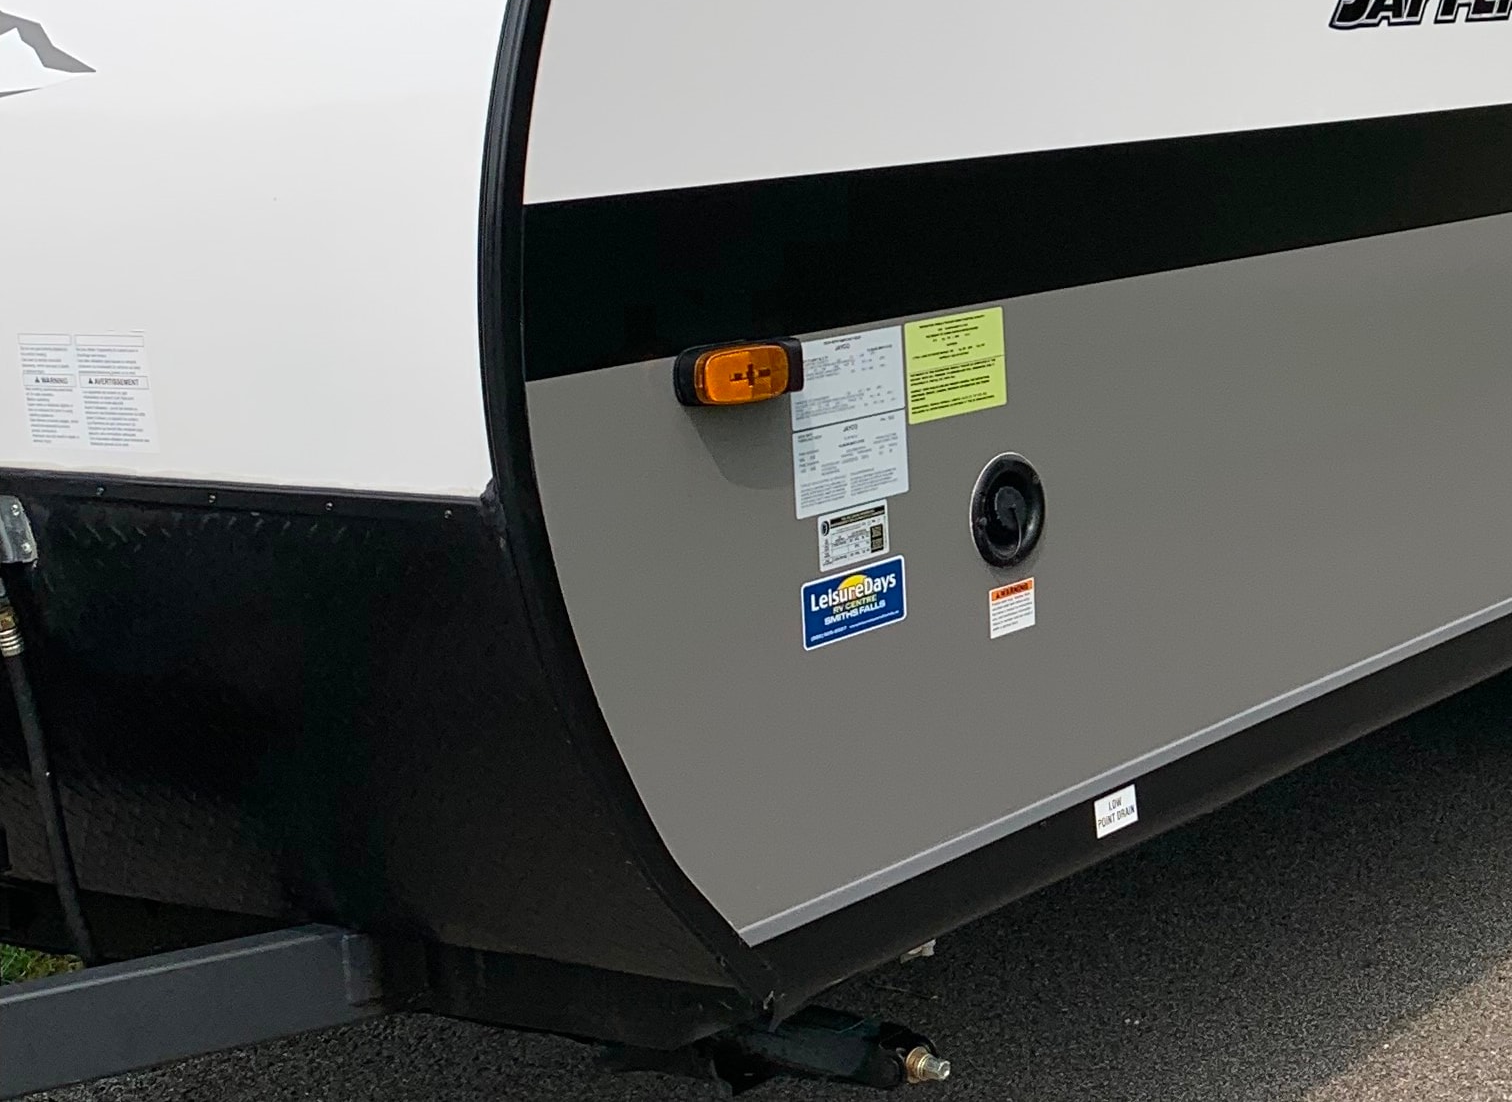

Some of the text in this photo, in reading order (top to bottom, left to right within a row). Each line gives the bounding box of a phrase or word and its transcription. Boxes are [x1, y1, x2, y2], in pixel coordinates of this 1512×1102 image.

[810, 573, 897, 612] LeisureDays
[833, 594, 877, 615] RV CENTRE
[824, 608, 859, 626] SMITHS
[859, 599, 886, 615] FALLS
[1098, 804, 1135, 829] POINT DRAIN
[1108, 797, 1122, 811] LOW
